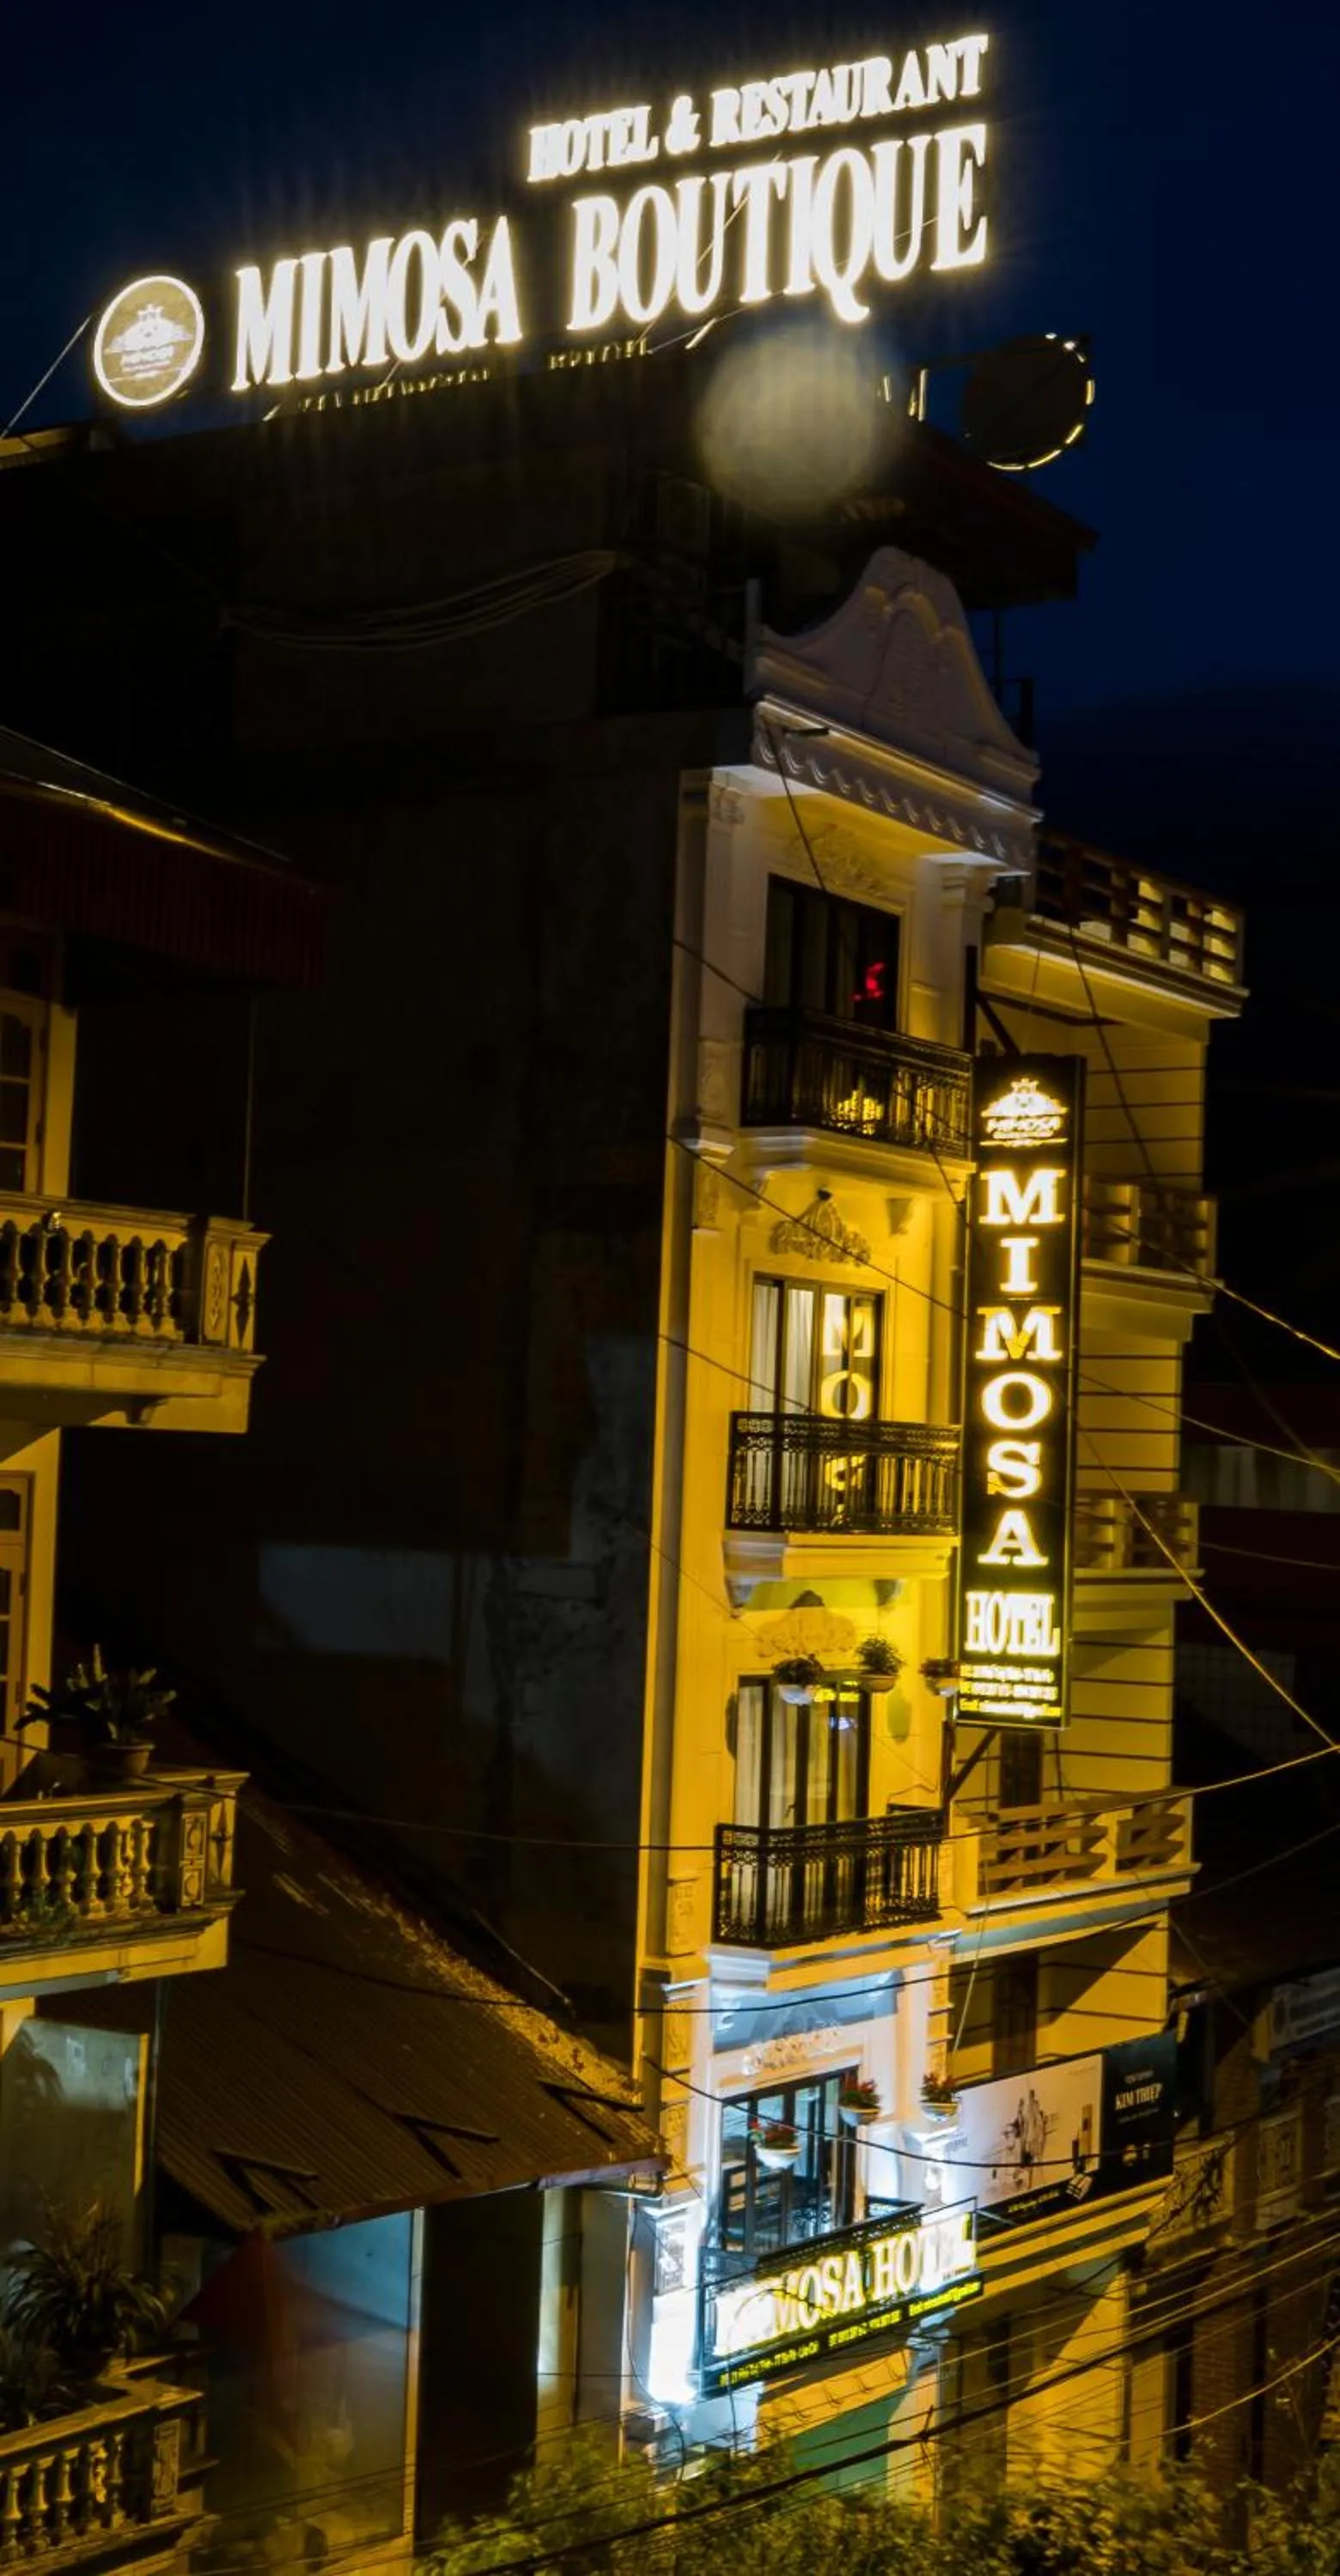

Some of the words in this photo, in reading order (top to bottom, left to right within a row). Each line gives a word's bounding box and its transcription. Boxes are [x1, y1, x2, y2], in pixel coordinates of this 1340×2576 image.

[527, 105, 658, 182] HOTEL
[666, 95, 701, 155] &
[710, 33, 989, 147] RESTAURANT
[229, 215, 522, 393] MIMOSA
[566, 124, 987, 323] BOUTIQUE
[965, 1591, 1061, 1656] HOTEL
[713, 2250, 865, 2357] MOSA
[872, 2211, 977, 2300] HOTL
